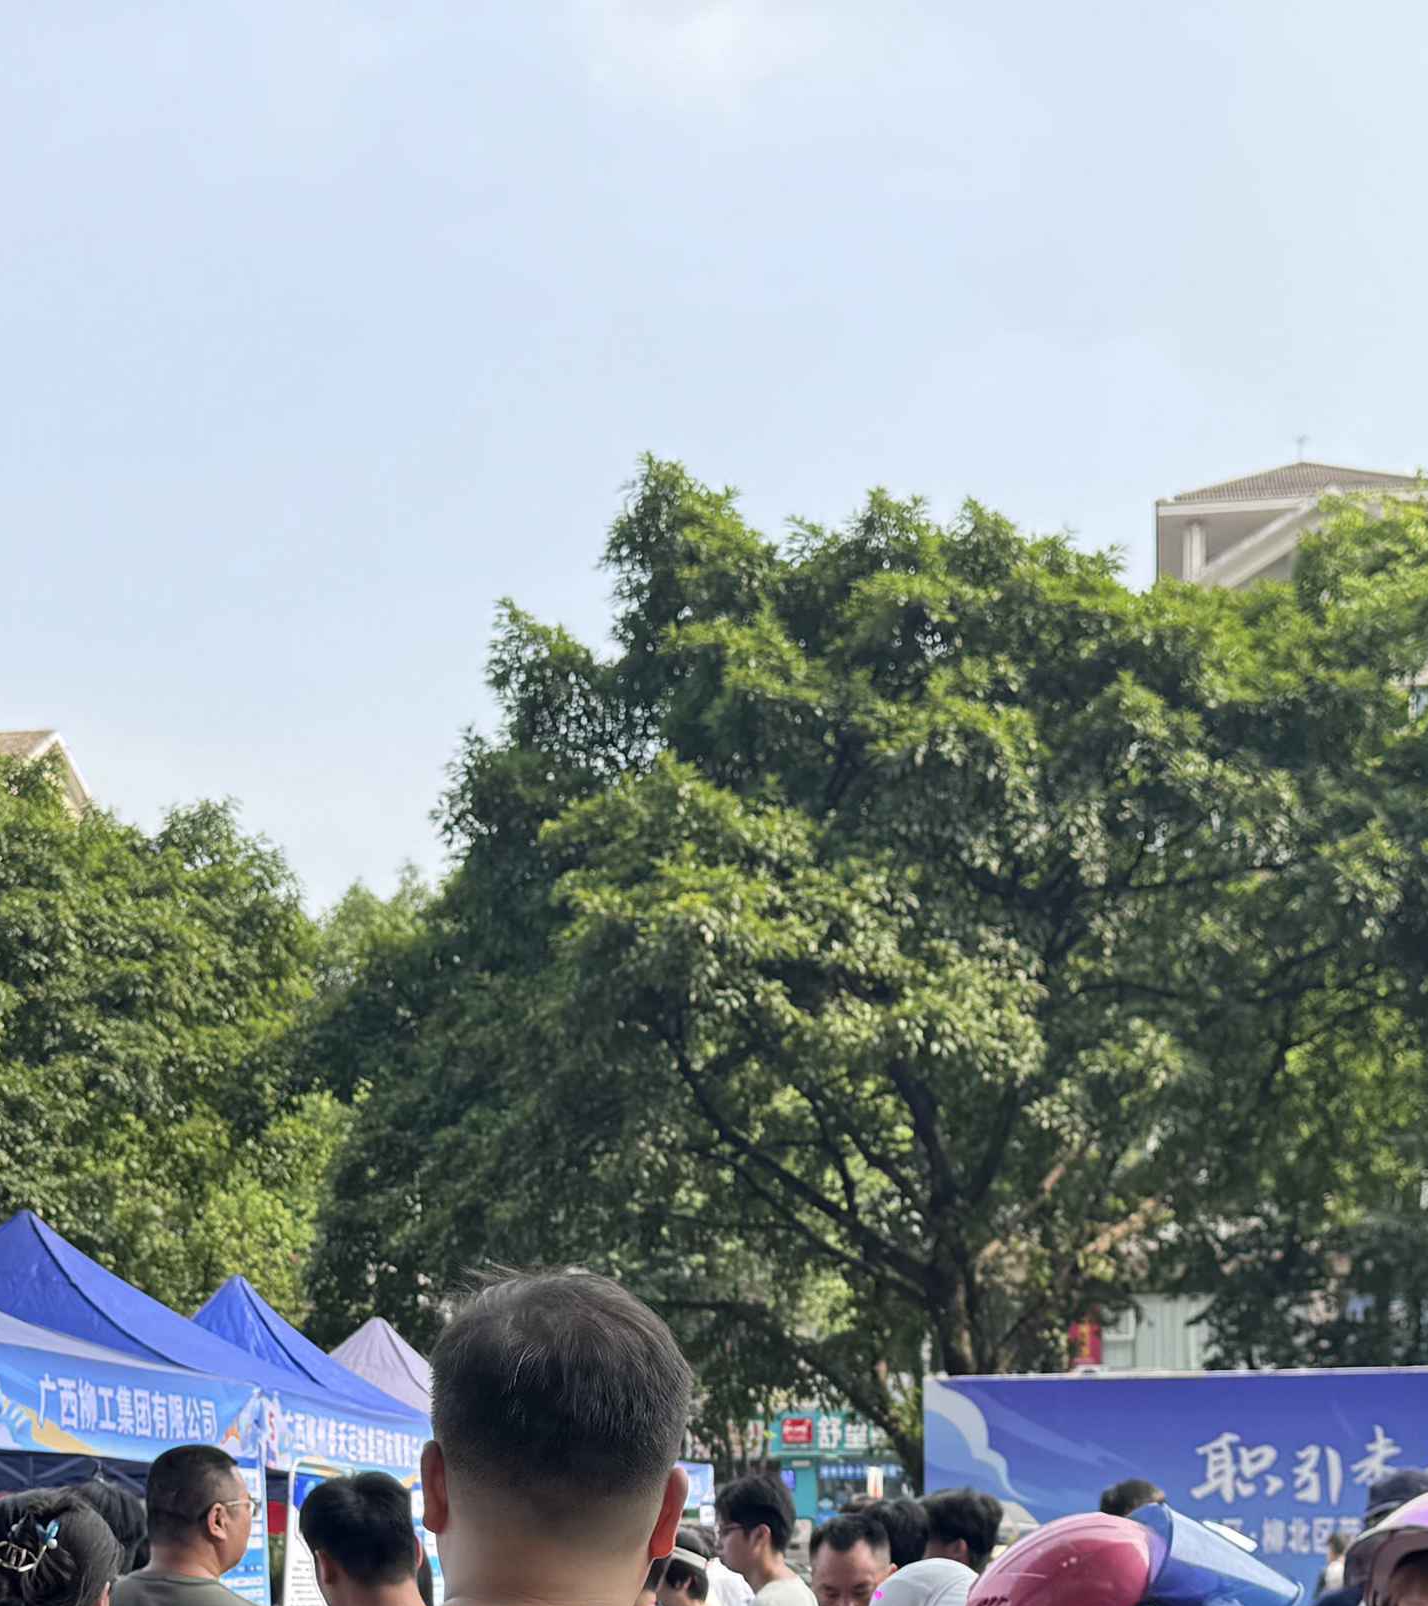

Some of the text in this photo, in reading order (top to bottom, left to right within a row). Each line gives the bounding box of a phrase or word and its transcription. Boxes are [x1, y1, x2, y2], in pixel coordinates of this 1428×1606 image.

[38, 1373, 218, 1440] 广西柳工集团有限公司
